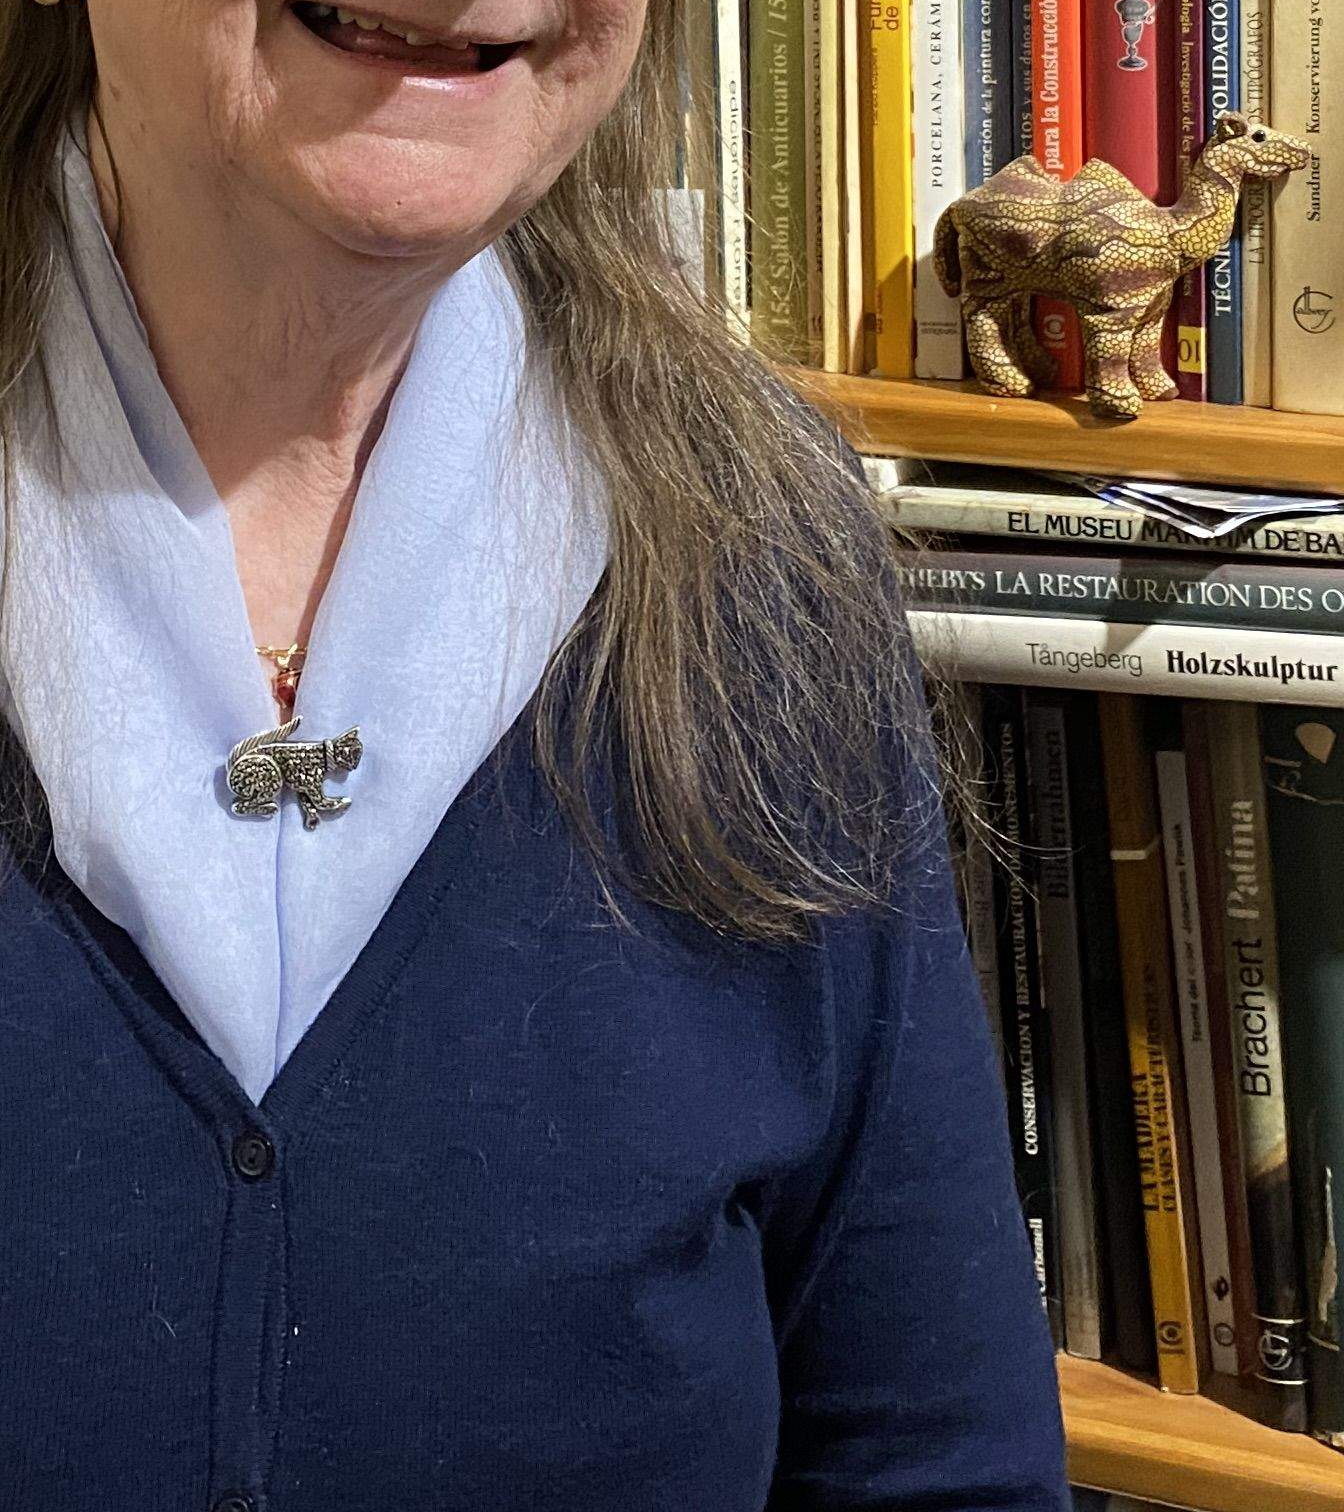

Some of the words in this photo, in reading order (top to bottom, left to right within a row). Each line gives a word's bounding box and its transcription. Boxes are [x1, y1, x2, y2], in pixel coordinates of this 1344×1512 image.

[929, 74, 943, 188] PORCELANA,
[995, 571, 1030, 595] LA
[1037, 574, 1250, 609] RESTAURATION
[1260, 584, 1313, 612] DES
[1026, 642, 1143, 676] Tångeberg
[1166, 649, 1337, 687] Holzskulptur
[1226, 800, 1259, 920] Patina
[1233, 937, 1271, 1097] Brachert
